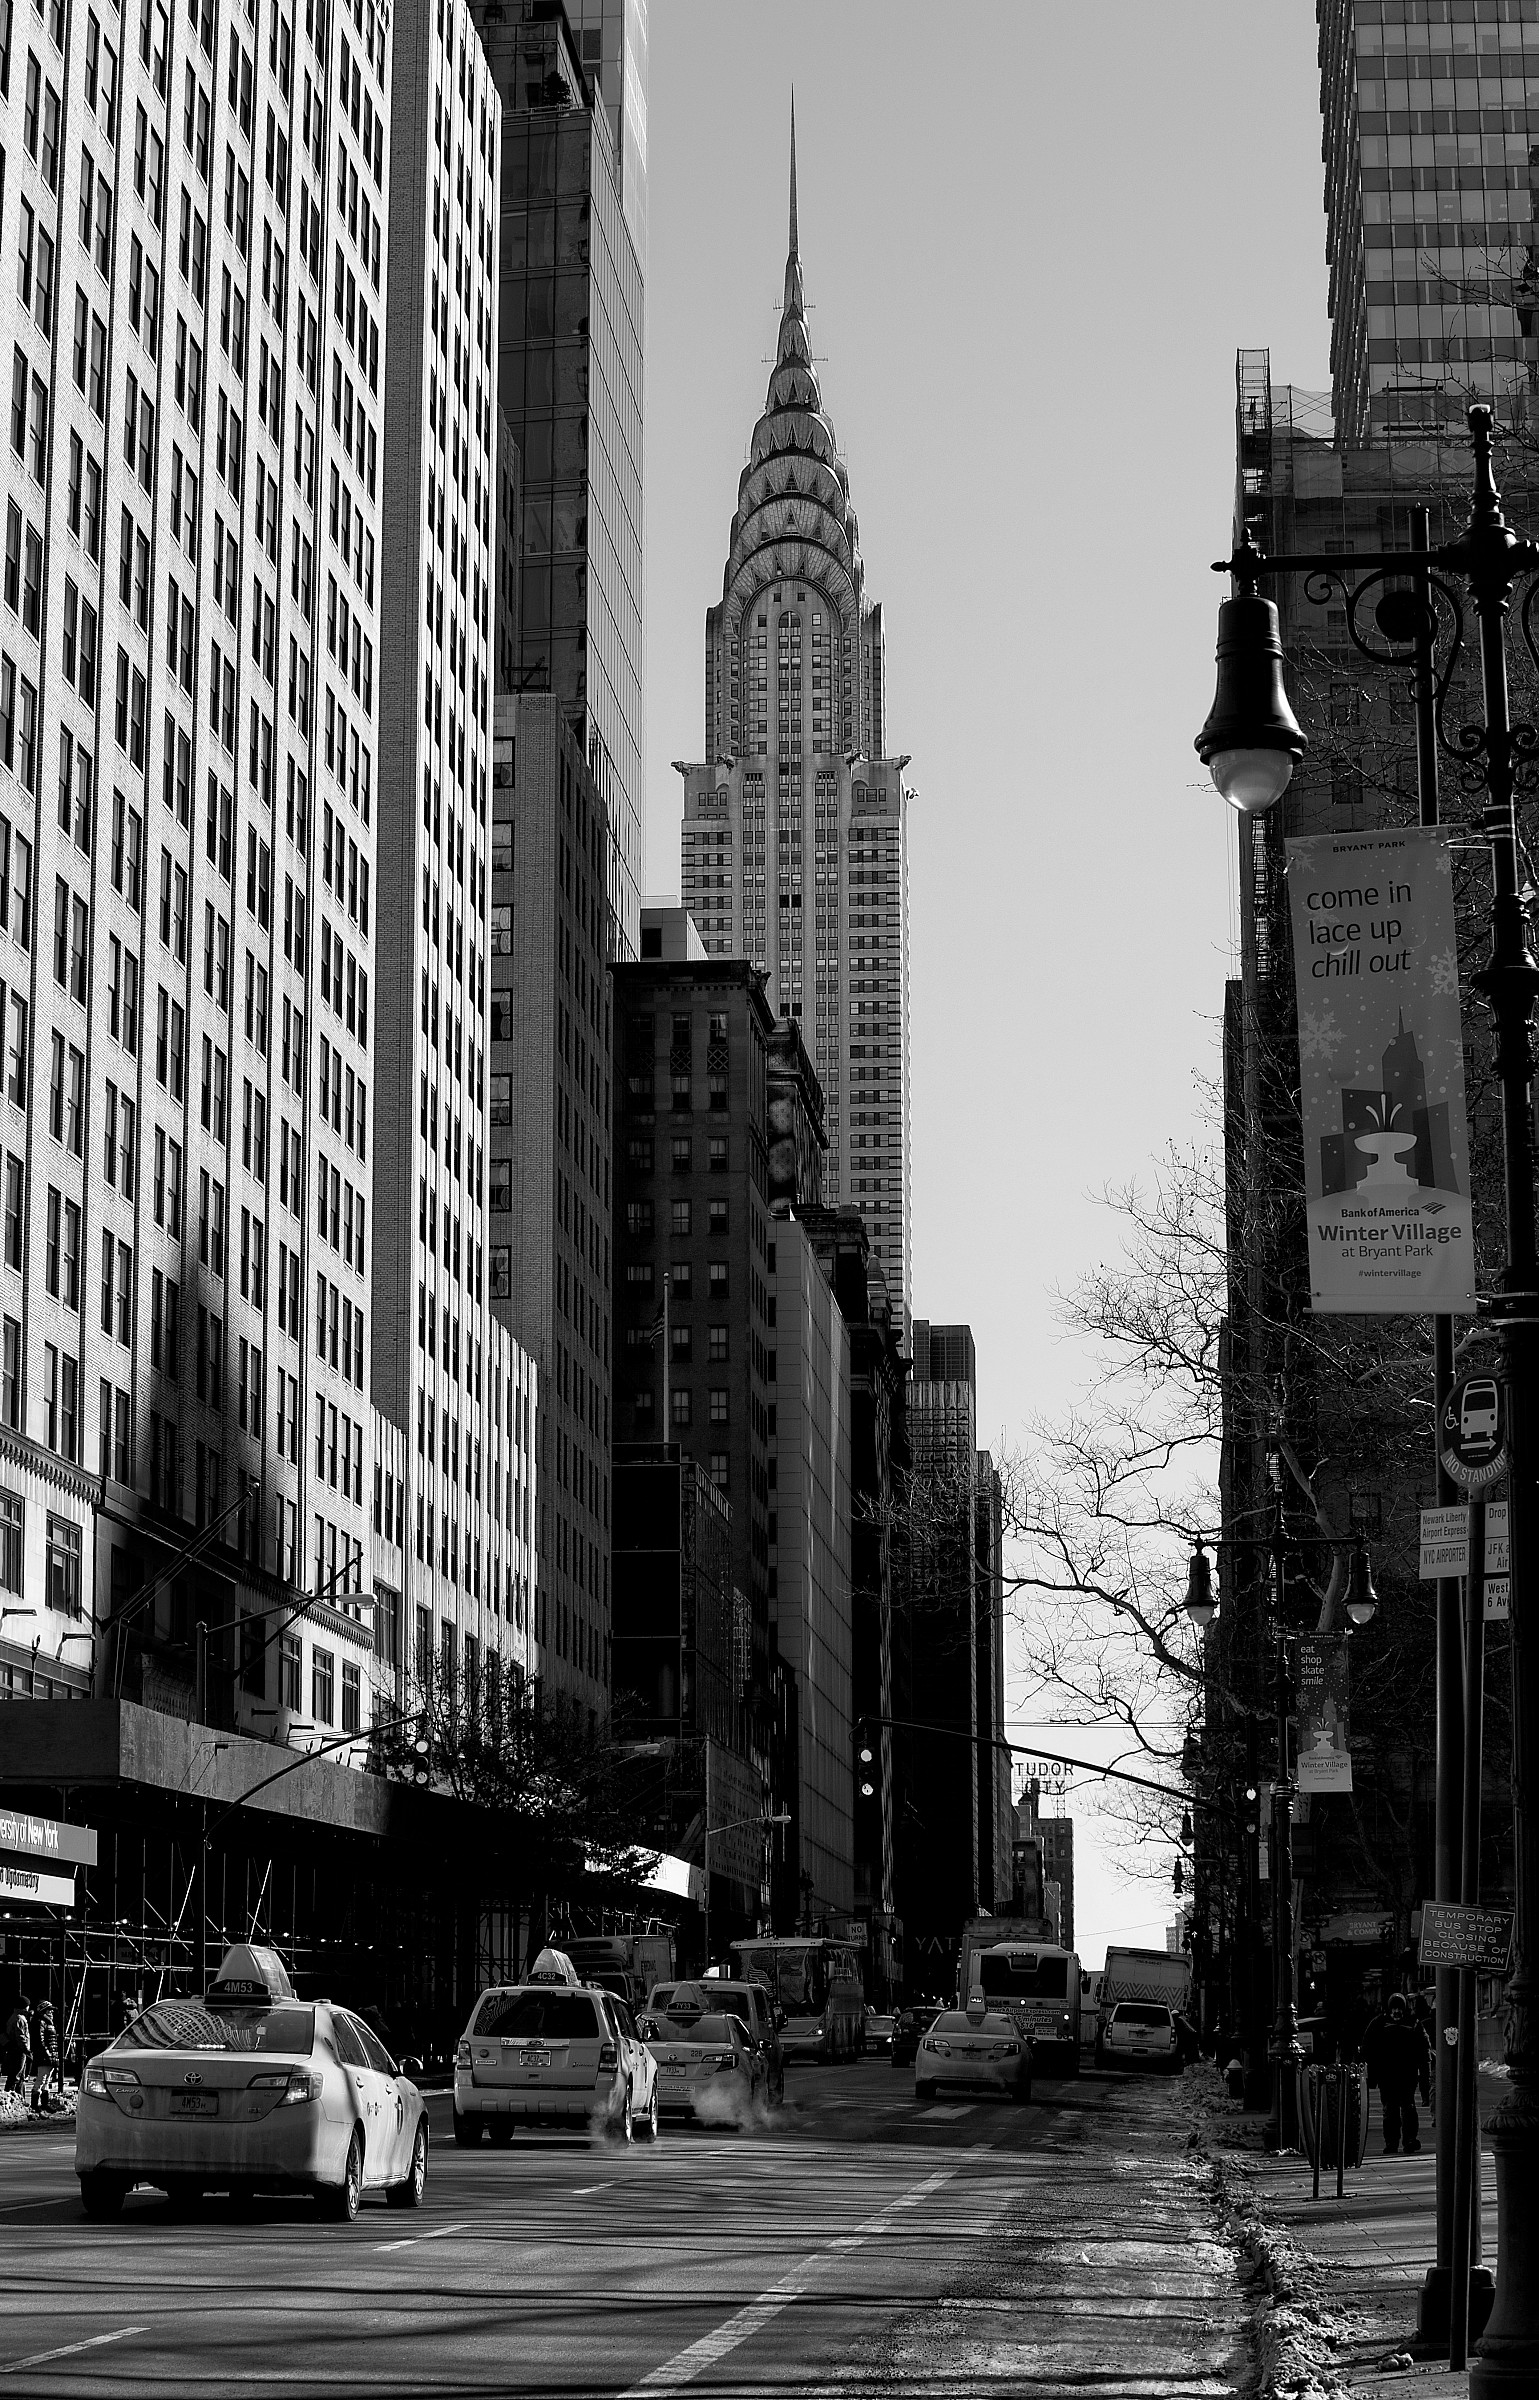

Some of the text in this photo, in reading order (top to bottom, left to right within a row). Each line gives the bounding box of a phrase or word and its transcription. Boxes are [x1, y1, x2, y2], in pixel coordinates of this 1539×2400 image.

[1333, 840, 1406, 853] BRYANT PARK
[1307, 880, 1412, 911] come in
[1309, 918, 1402, 945] lace up
[1311, 949, 1411, 978] chill out
[1341, 1207, 1420, 1218] Bank of America
[1317, 1223, 1462, 1244] Winter Village
[1341, 1244, 1433, 1260] at Bryant Park
[1358, 1269, 1422, 1278] #wintervillage
[1445, 1454, 1460, 1474] NO
[1422, 1512, 1467, 1525] Newark Liberty
[1489, 1507, 1507, 1520] Drop
[1422, 1526, 1467, 1540] Airport Express
[1423, 1546, 1466, 1565] NYC AIRPORTER
[1487, 1543, 1504, 1555] JFK
[1487, 1582, 1509, 1595] West
[1487, 1597, 1493, 1608] 6
[1300, 1645, 1316, 1654] eat
[1300, 1654, 1323, 1666] shop
[1300, 1665, 1325, 1675] skate
[1300, 1676, 1324, 1686] smile
[1015, 1762, 1074, 1776] TUDOR
[1301, 1761, 1348, 1769] Winter Village
[20, 1816, 28, 1843] of
[28, 1816, 44, 1846] New
[43, 1820, 59, 1850] York
[1429, 1909, 1510, 1925] TEMPORARY
[851, 1925, 862, 1934] NO
[1349, 1921, 1377, 1929] BRYANT
[1434, 1920, 1503, 1934] BUS STOP
[1438, 1931, 1497, 1944] CLOSING
[914, 1936, 961, 1955] YAT
[1423, 1939, 1508, 1954] BECAUSE OF
[1424, 1950, 1505, 1965] CONSTRUCTION
[537, 1972, 556, 1980] 4C32
[223, 1981, 253, 1993] 4M53
[675, 2002, 691, 2010] 7Y33
[987, 2006, 1061, 2015] ewarkAirportExpress.com
[1022, 2014, 1053, 2024] minutes
